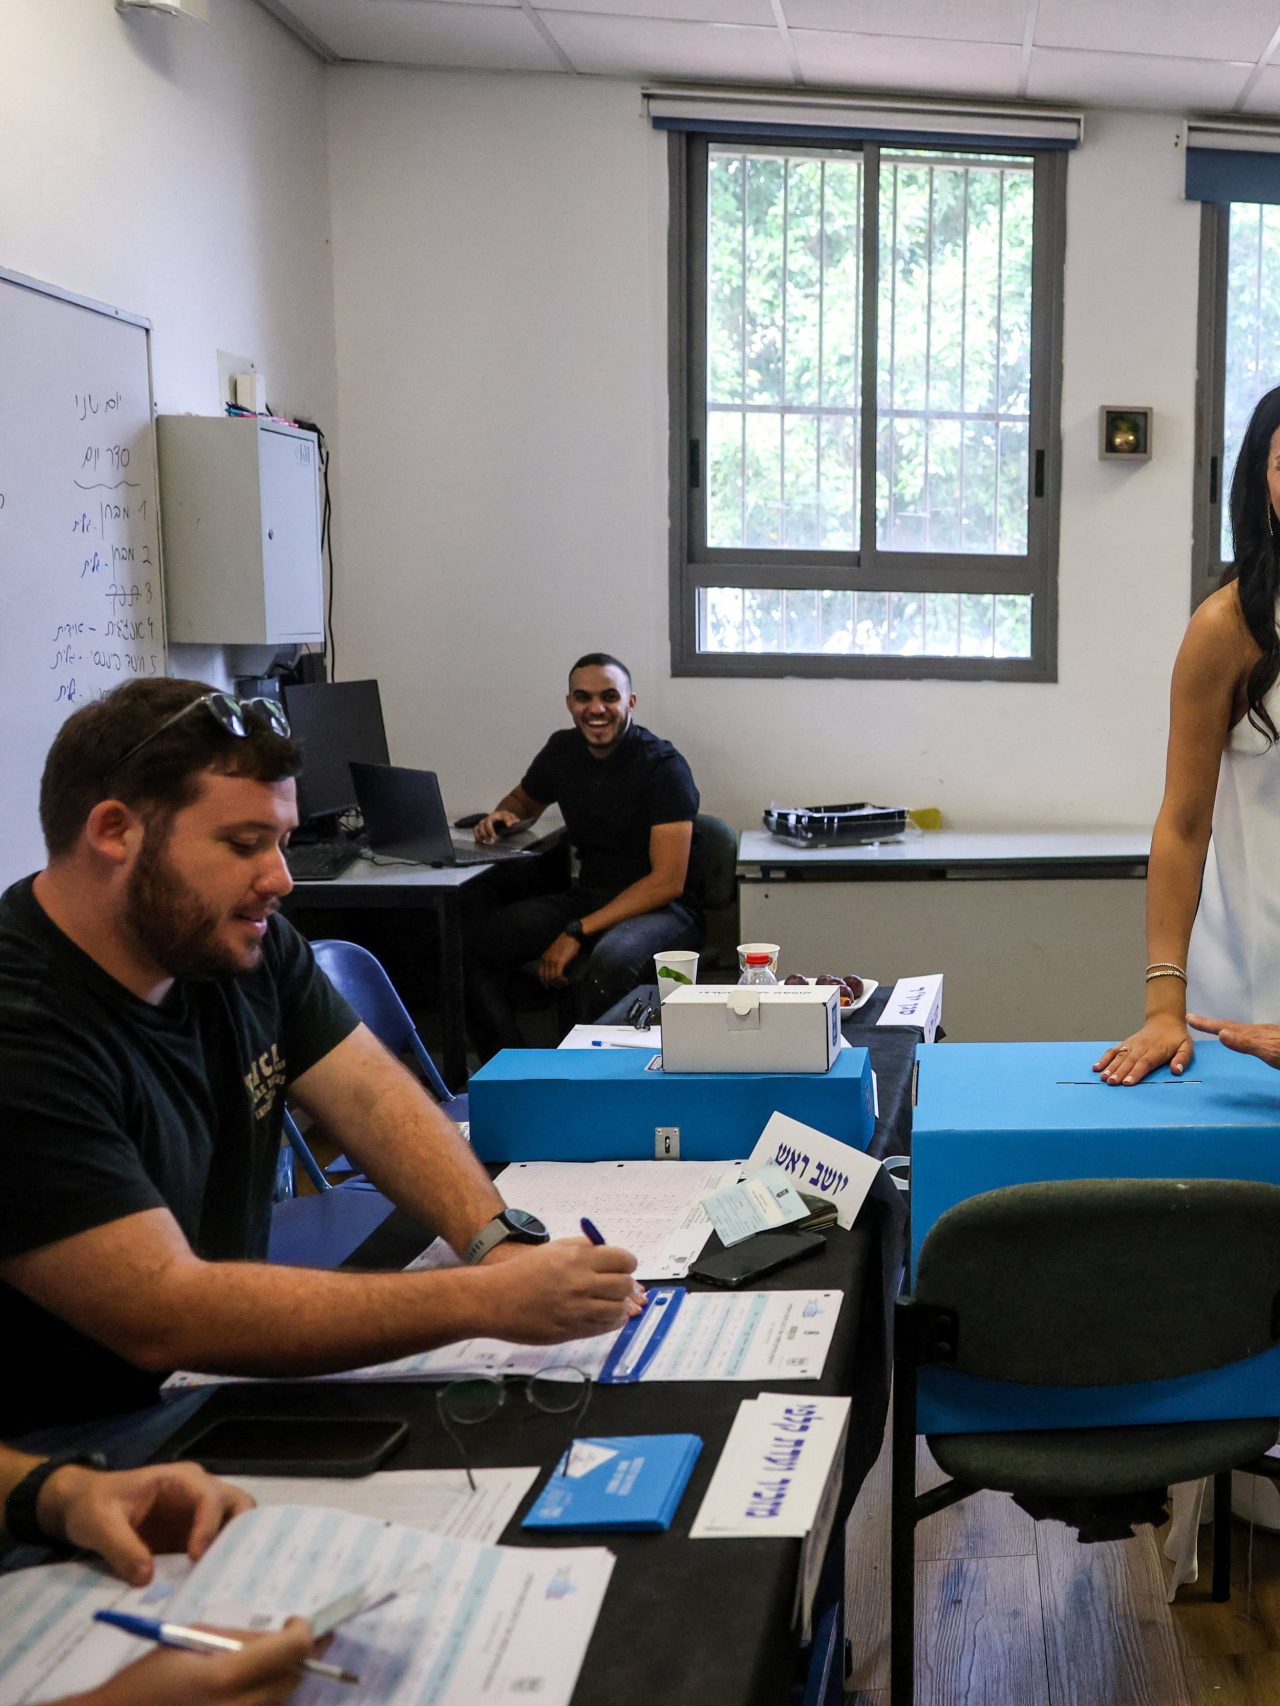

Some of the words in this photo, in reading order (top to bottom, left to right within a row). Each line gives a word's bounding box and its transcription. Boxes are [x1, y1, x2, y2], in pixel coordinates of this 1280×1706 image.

[104, 391, 122, 414] יום
[142, 545, 152, 566] 2
[774, 1141, 810, 1179] ראש
[808, 1161, 849, 1196] יושב
[771, 1404, 824, 1432] קלפי
[763, 1436, 805, 1472] ועדת
[744, 1478, 791, 1518] מזכיר
